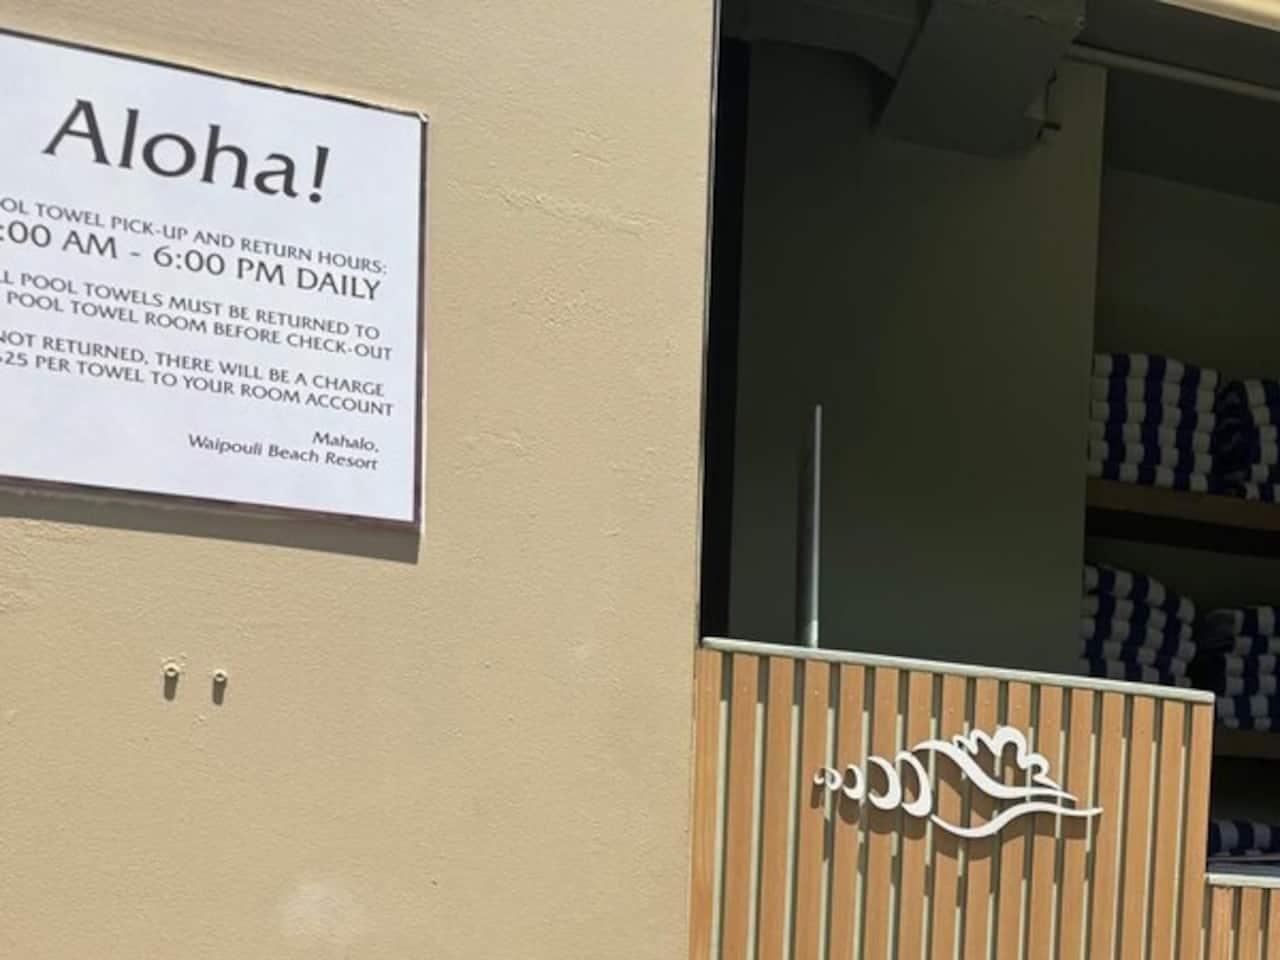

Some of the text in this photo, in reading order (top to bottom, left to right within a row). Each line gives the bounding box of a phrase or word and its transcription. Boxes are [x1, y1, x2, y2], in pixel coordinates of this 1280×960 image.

[41, 98, 330, 203] Aloha!
[35, 202, 105, 228] TOWEL
[111, 216, 188, 241] PICK-UP
[193, 230, 235, 249] AND
[241, 238, 312, 262] RETURN
[318, 251, 387, 275] HOURS:
[62, 230, 117, 259] AM
[154, 246, 225, 276] 6:00
[236, 257, 285, 286] PM
[297, 268, 381, 300] DAILY
[7, 290, 393, 361] POOL TOWEL ROOM BEFORE CHECK-OUT
[21, 272, 78, 295] POOL
[83, 282, 163, 308] TOWELS
[168, 297, 223, 316] MUST
[229, 305, 250, 320] BE
[256, 310, 349, 336] RETURNED
[355, 324, 380, 340] TO
[36, 355, 71, 374] PER
[77, 360, 144, 383] TOWEL
[151, 371, 177, 386] TO
[183, 376, 234, 395] YOUR
[240, 384, 300, 404] ROOM
[305, 394, 394, 416] ACCOUNT
[155, 352, 214, 373] THERE
[219, 361, 263, 381] WILL
[269, 370, 289, 384] BE
[294, 373, 308, 386] A
[312, 375, 384, 397] CHARGE
[188, 433, 378, 470] Waipouli Beach Resort
